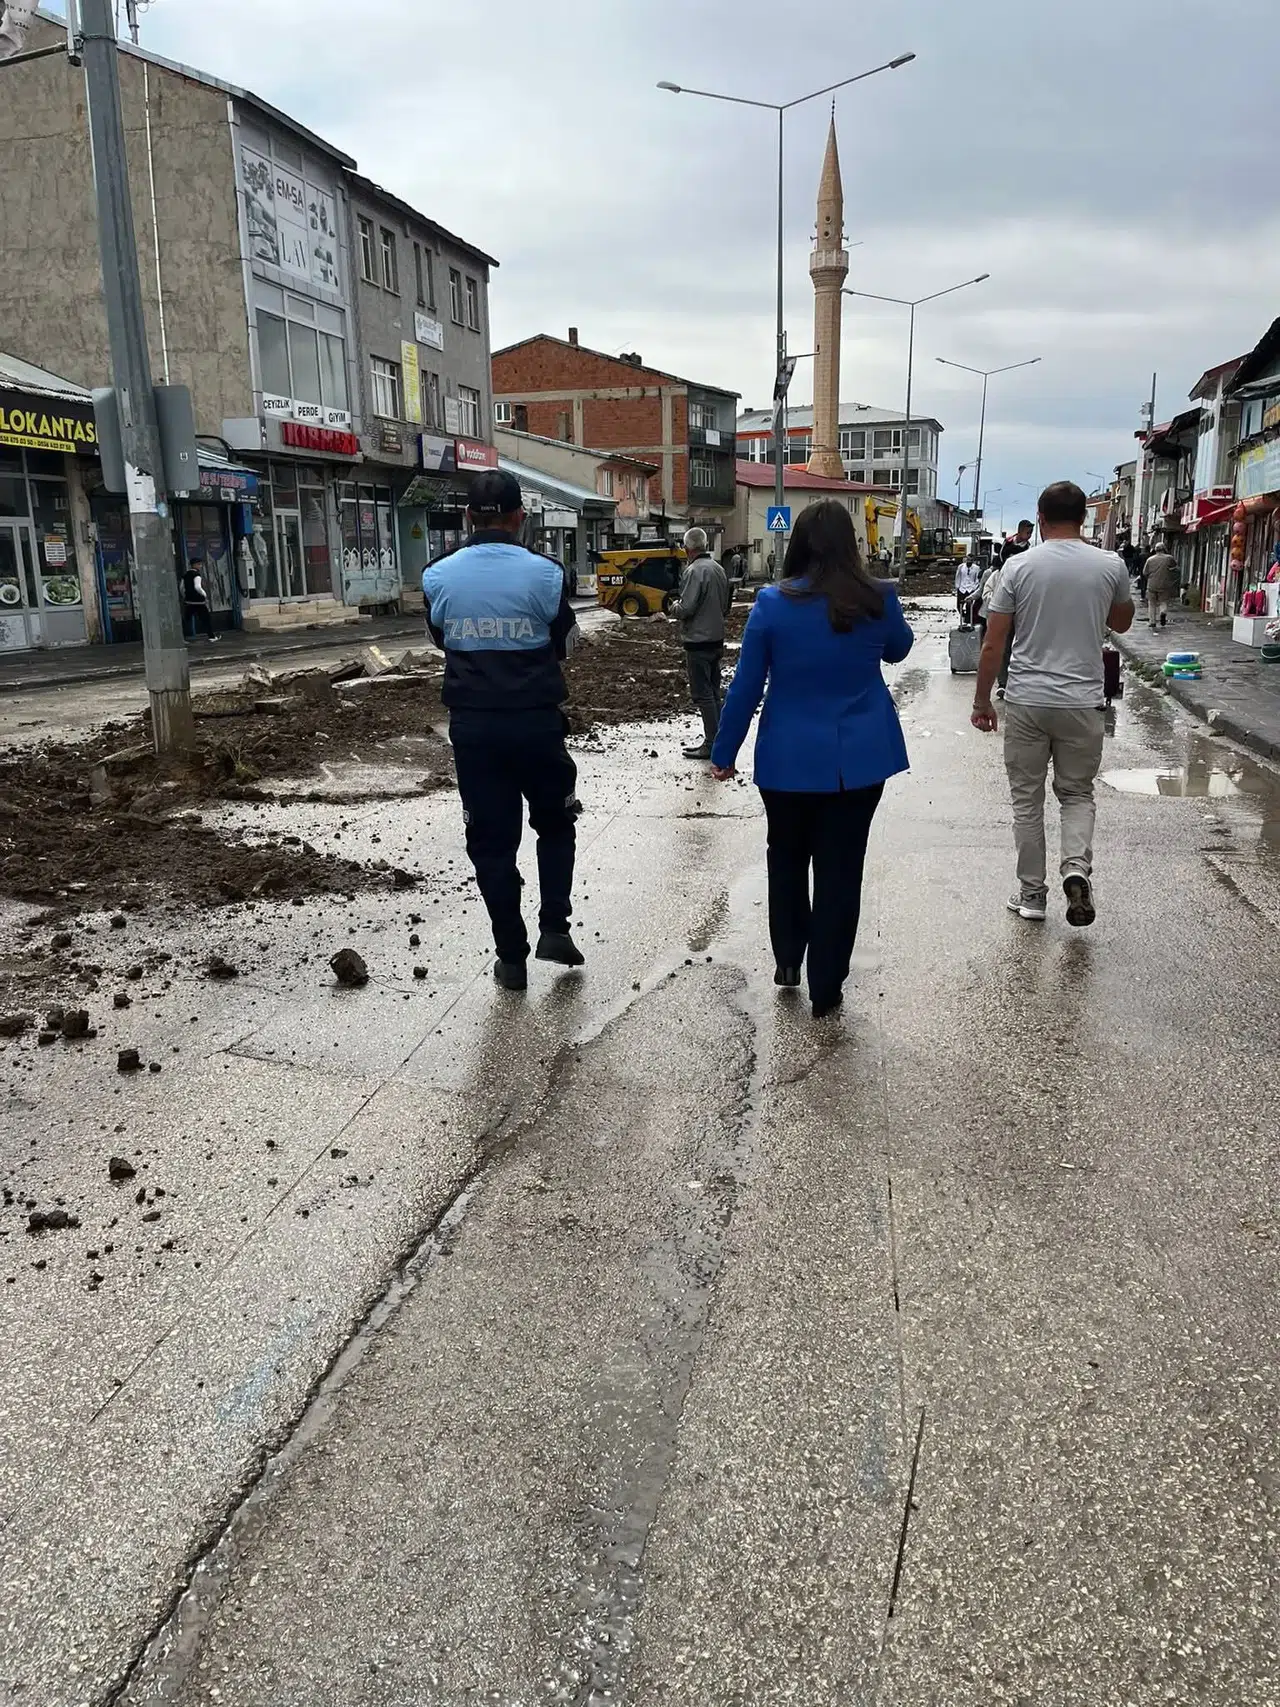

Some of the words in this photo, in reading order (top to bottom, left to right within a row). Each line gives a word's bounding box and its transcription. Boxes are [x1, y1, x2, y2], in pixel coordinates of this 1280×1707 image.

[276, 178, 304, 209] EM-SA
[297, 406, 319, 417] PERDE
[328, 412, 346, 423] GİYİM
[611, 575, 624, 585] CAT
[445, 617, 535, 640] ZABITA
